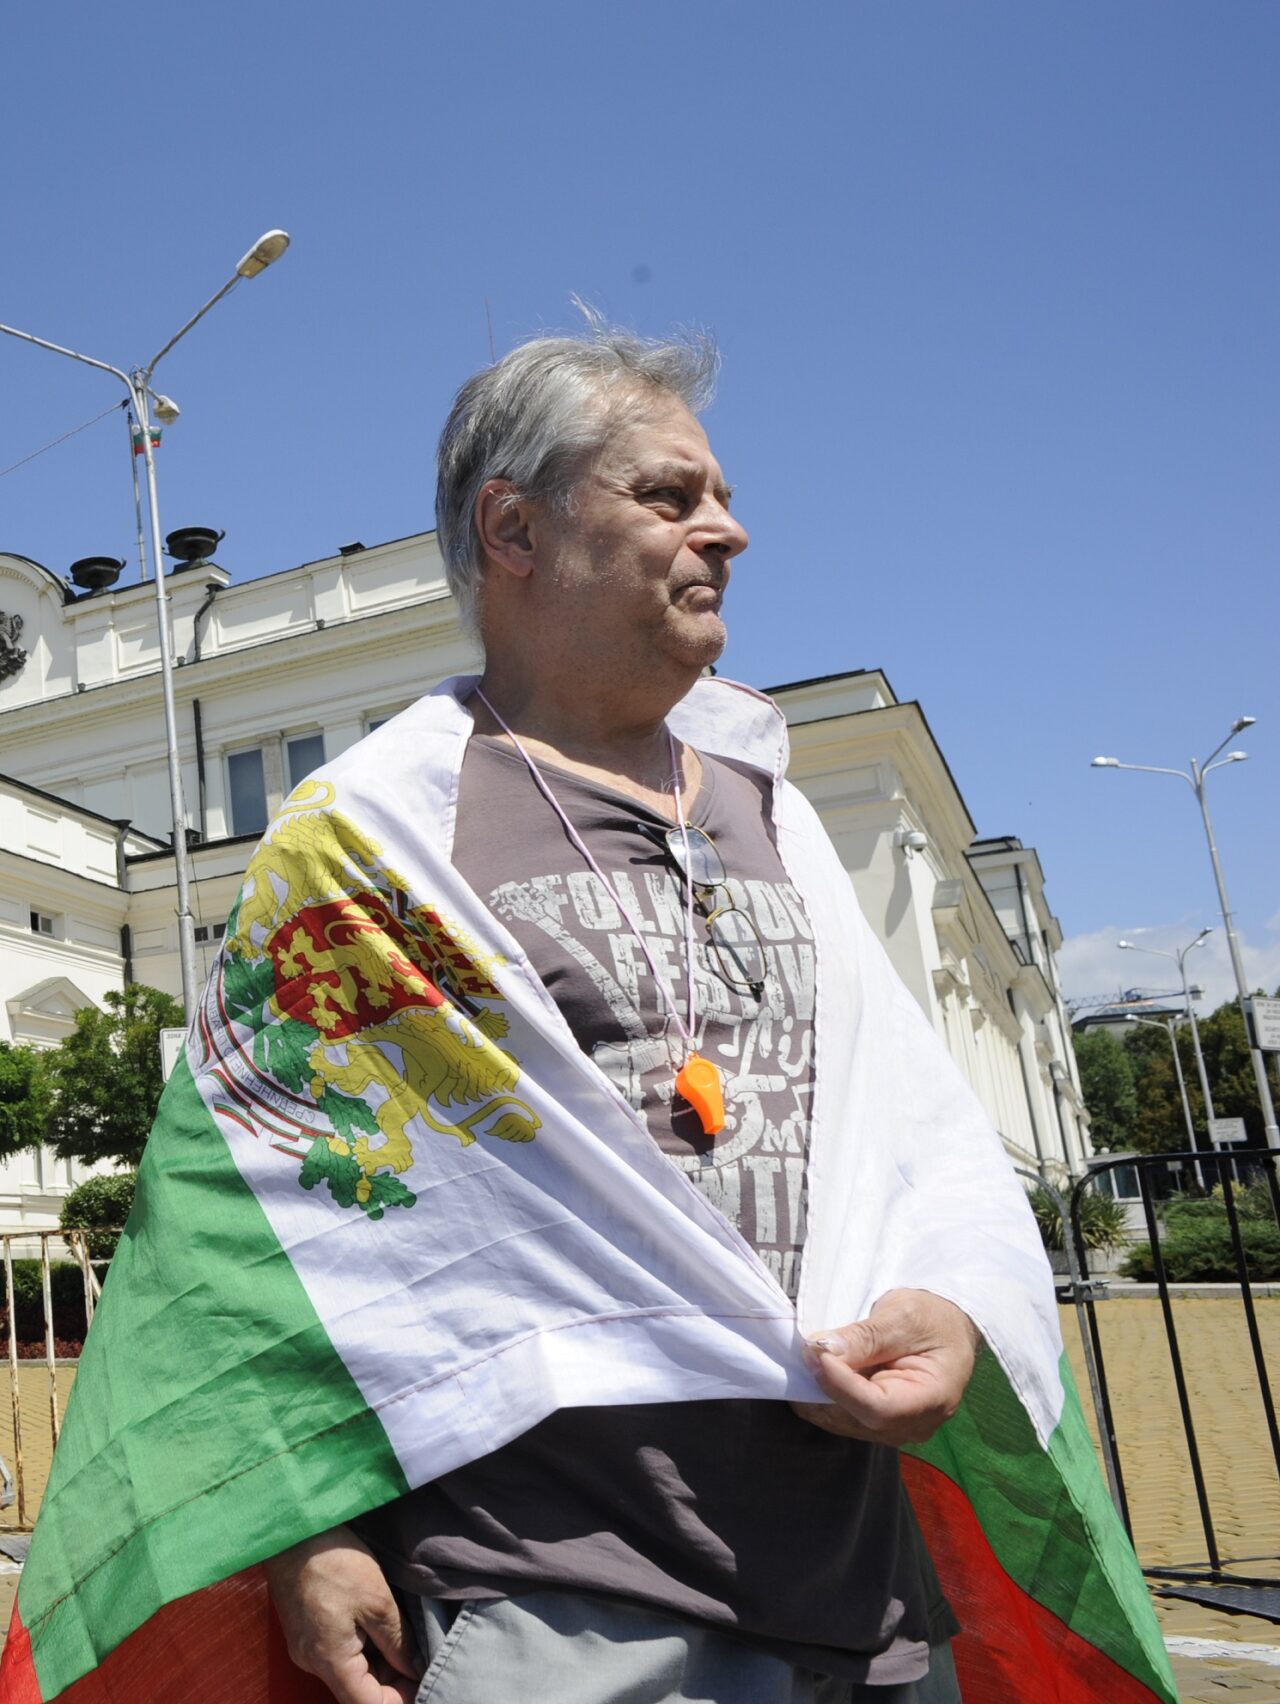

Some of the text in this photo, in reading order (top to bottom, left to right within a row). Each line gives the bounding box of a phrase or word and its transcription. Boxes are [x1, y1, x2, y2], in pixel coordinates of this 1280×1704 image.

[531, 871, 816, 942] FOLK ROC
[608, 933, 816, 1021] FESTIV
